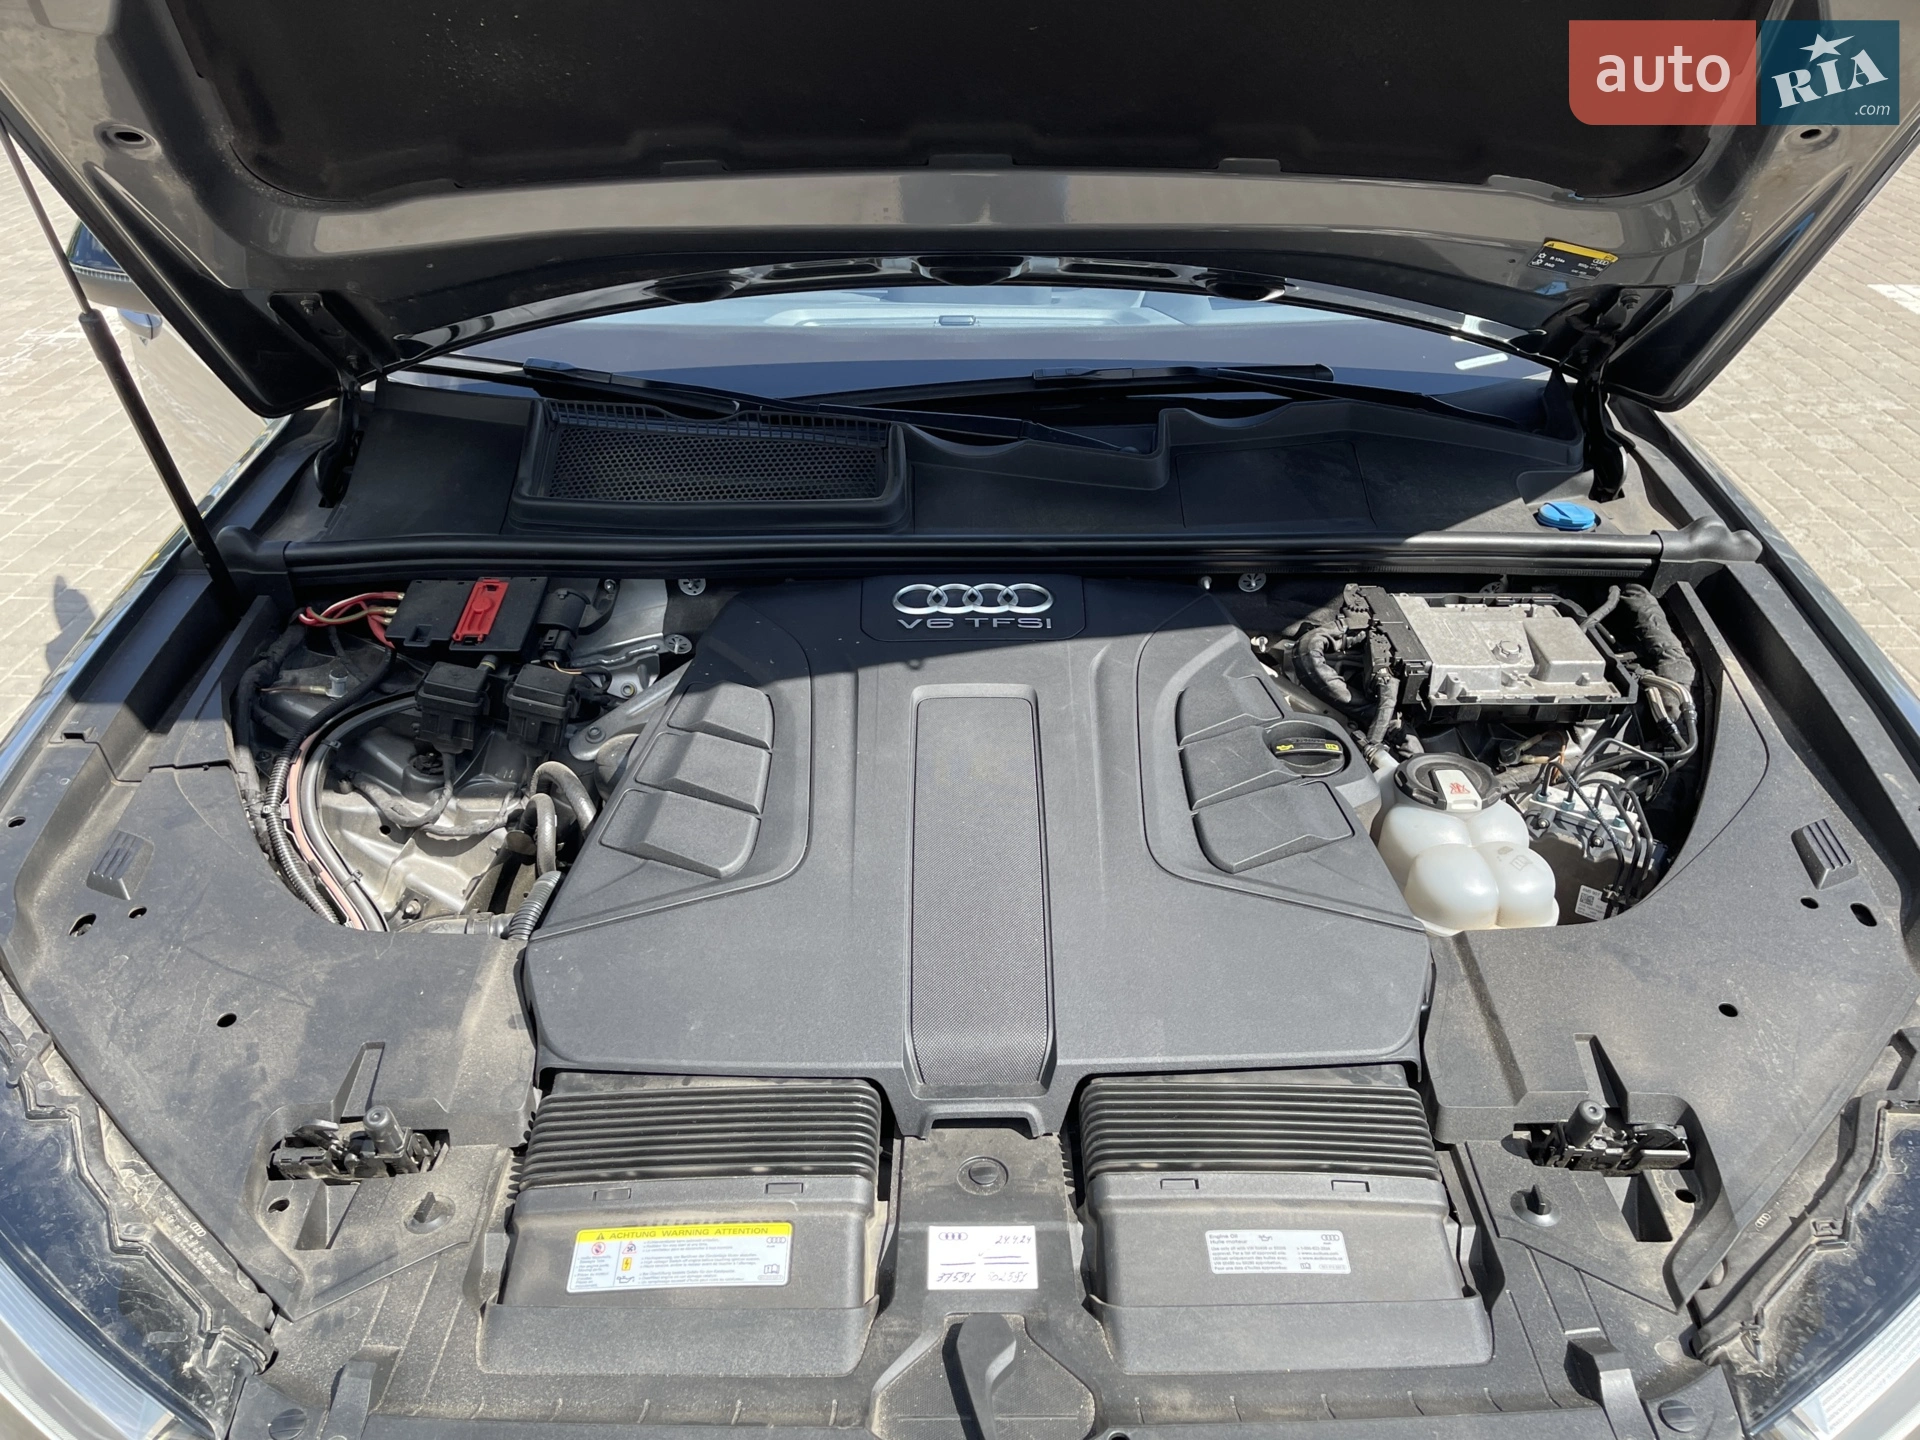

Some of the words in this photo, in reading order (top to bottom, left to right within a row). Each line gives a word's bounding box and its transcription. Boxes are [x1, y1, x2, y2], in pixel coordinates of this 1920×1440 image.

[897, 618, 954, 629] V6
[965, 617, 1052, 629] TFSI
[609, 1230, 657, 1240] ACHTUNG
[662, 1229, 710, 1237] WARNING
[714, 1227, 769, 1235] ATTENTION
